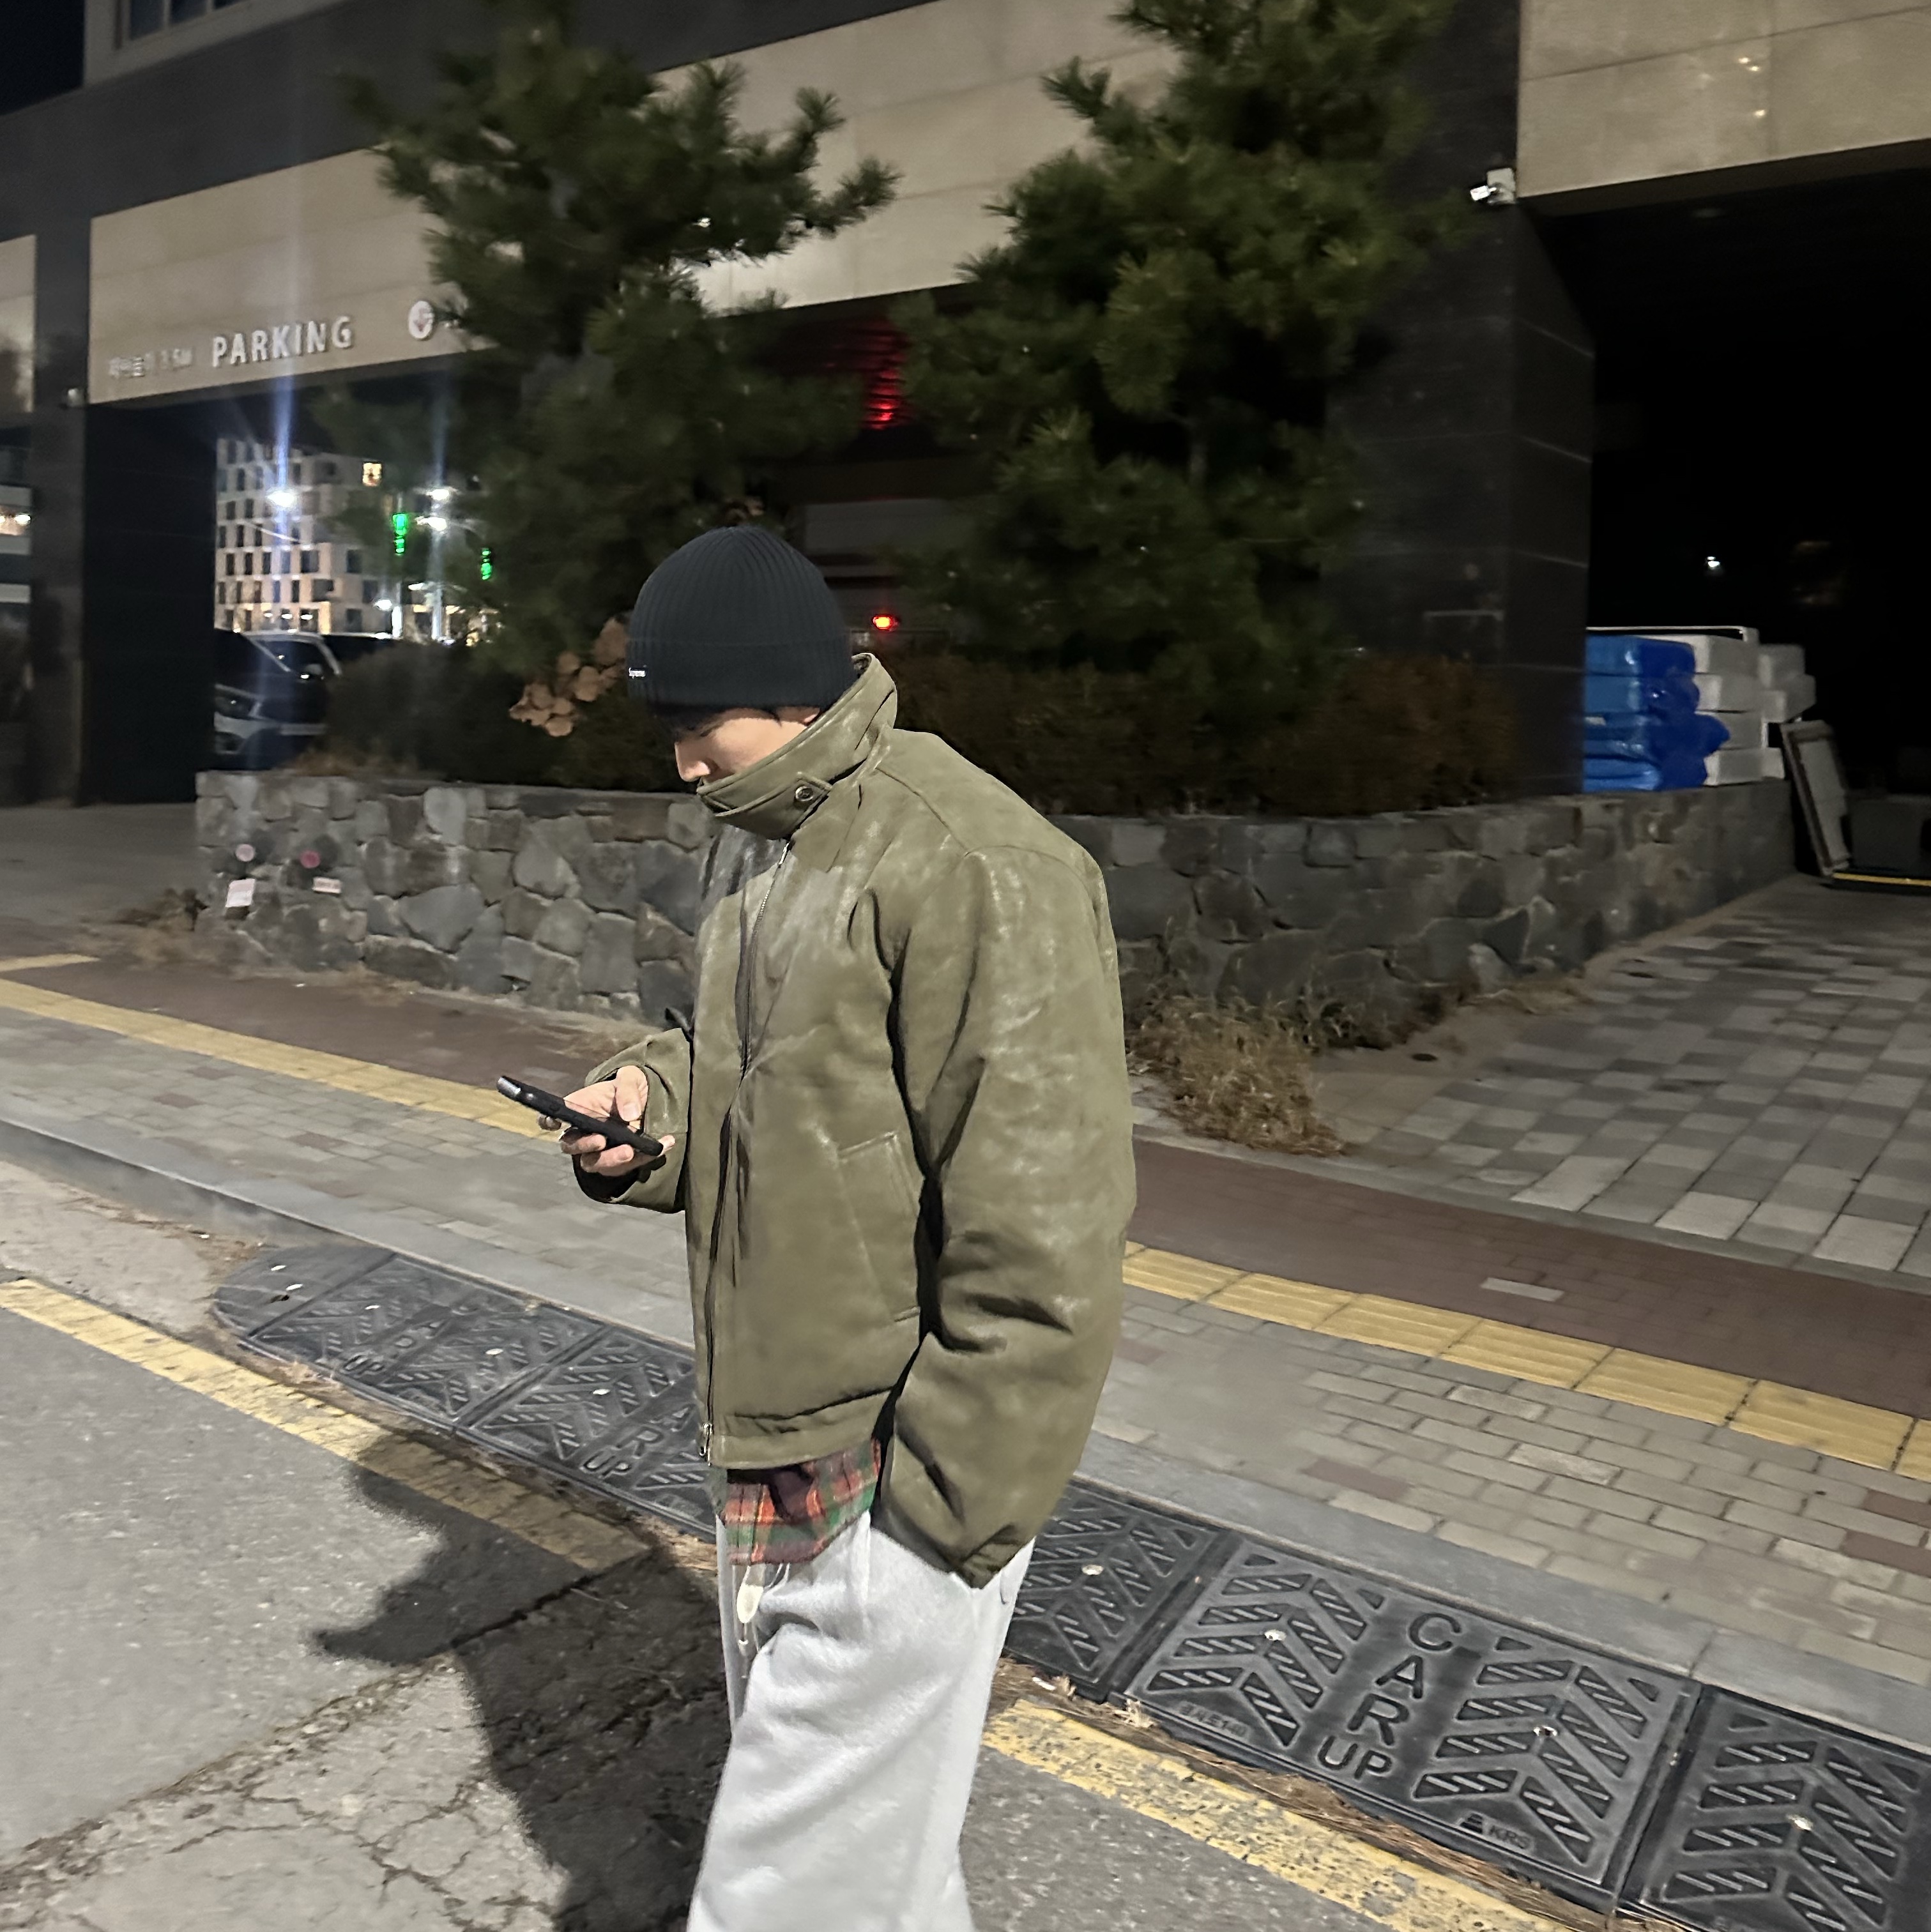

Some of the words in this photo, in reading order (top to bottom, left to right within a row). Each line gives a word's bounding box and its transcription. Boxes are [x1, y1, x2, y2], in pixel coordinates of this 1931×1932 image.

[212, 316, 353, 368] PARKING
[344, 1353, 385, 1378] UP
[583, 1450, 631, 1478] UP
[1347, 1612, 1462, 1746] CAR
[1317, 1735, 1393, 1780] UP
